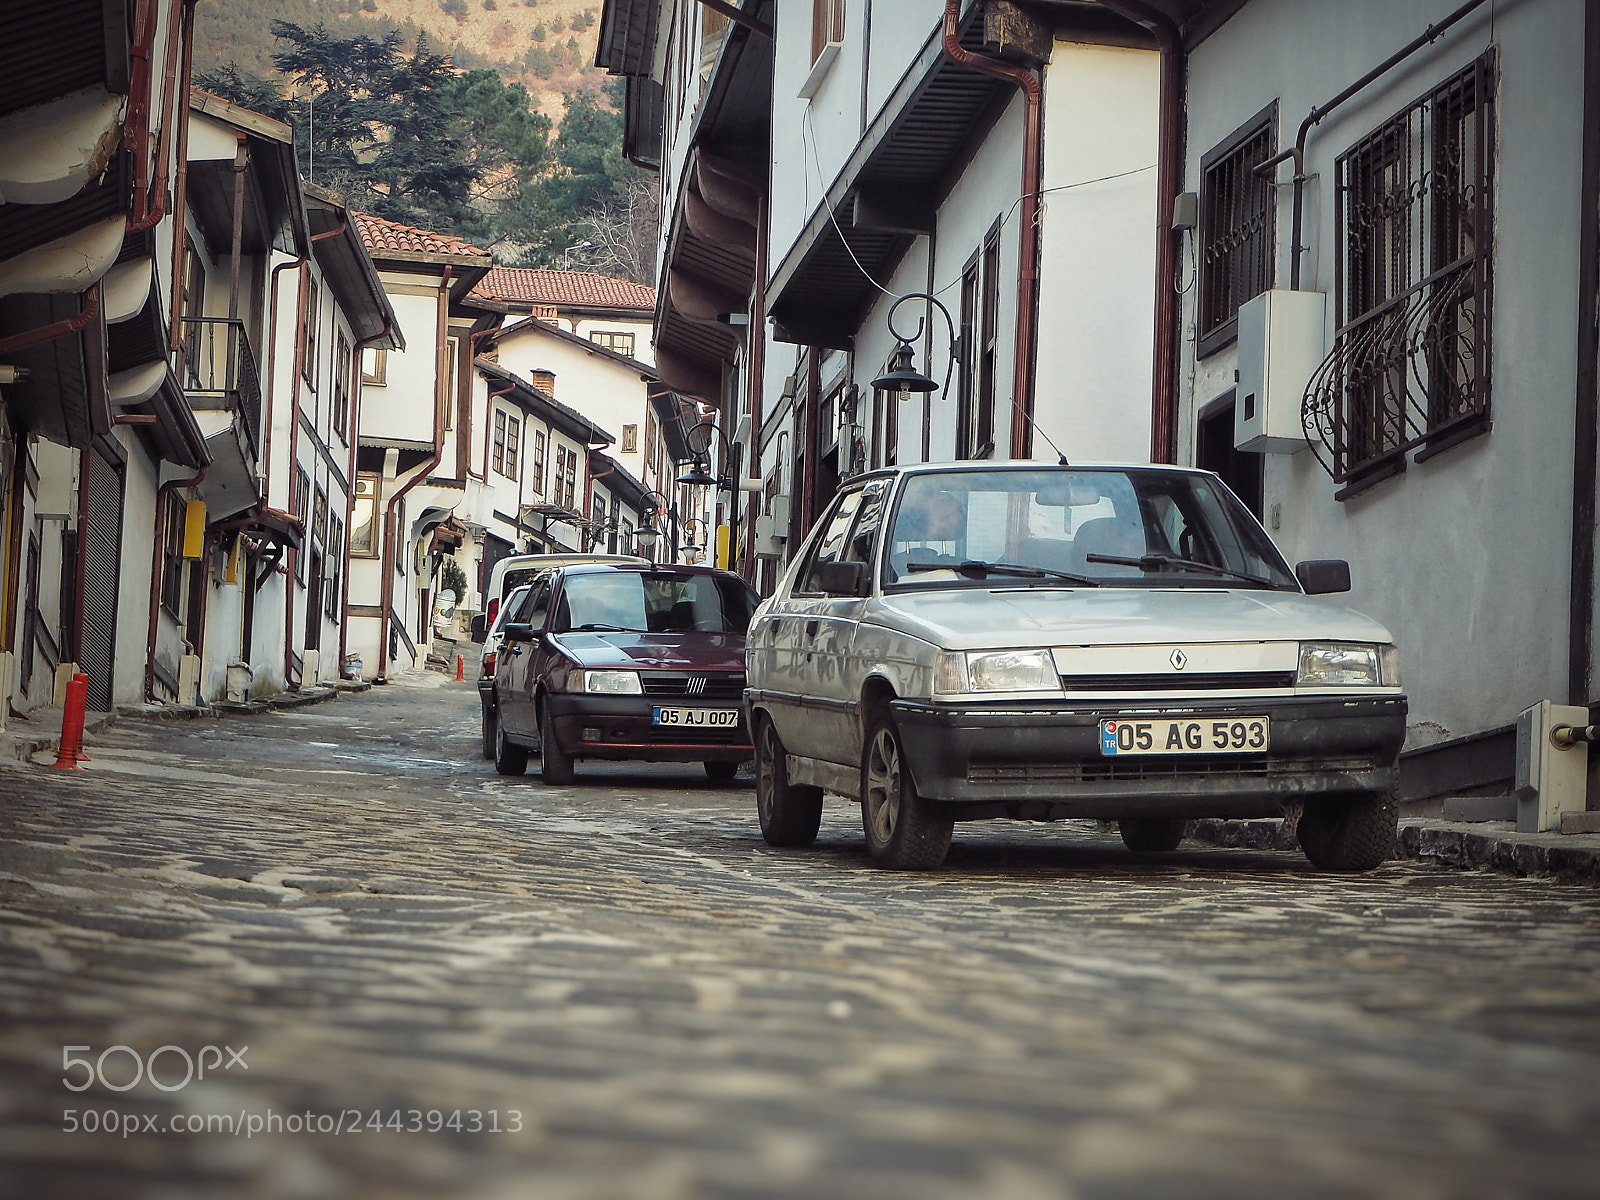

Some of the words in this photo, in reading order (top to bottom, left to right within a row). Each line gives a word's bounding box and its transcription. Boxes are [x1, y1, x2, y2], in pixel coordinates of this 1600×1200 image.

[661, 710, 679, 723] 05
[685, 711, 705, 724] AJ
[709, 712, 737, 725] 007
[1105, 739, 1116, 748] TR
[1117, 723, 1153, 750] 05
[1165, 723, 1202, 750] AG
[1212, 722, 1265, 749] 593
